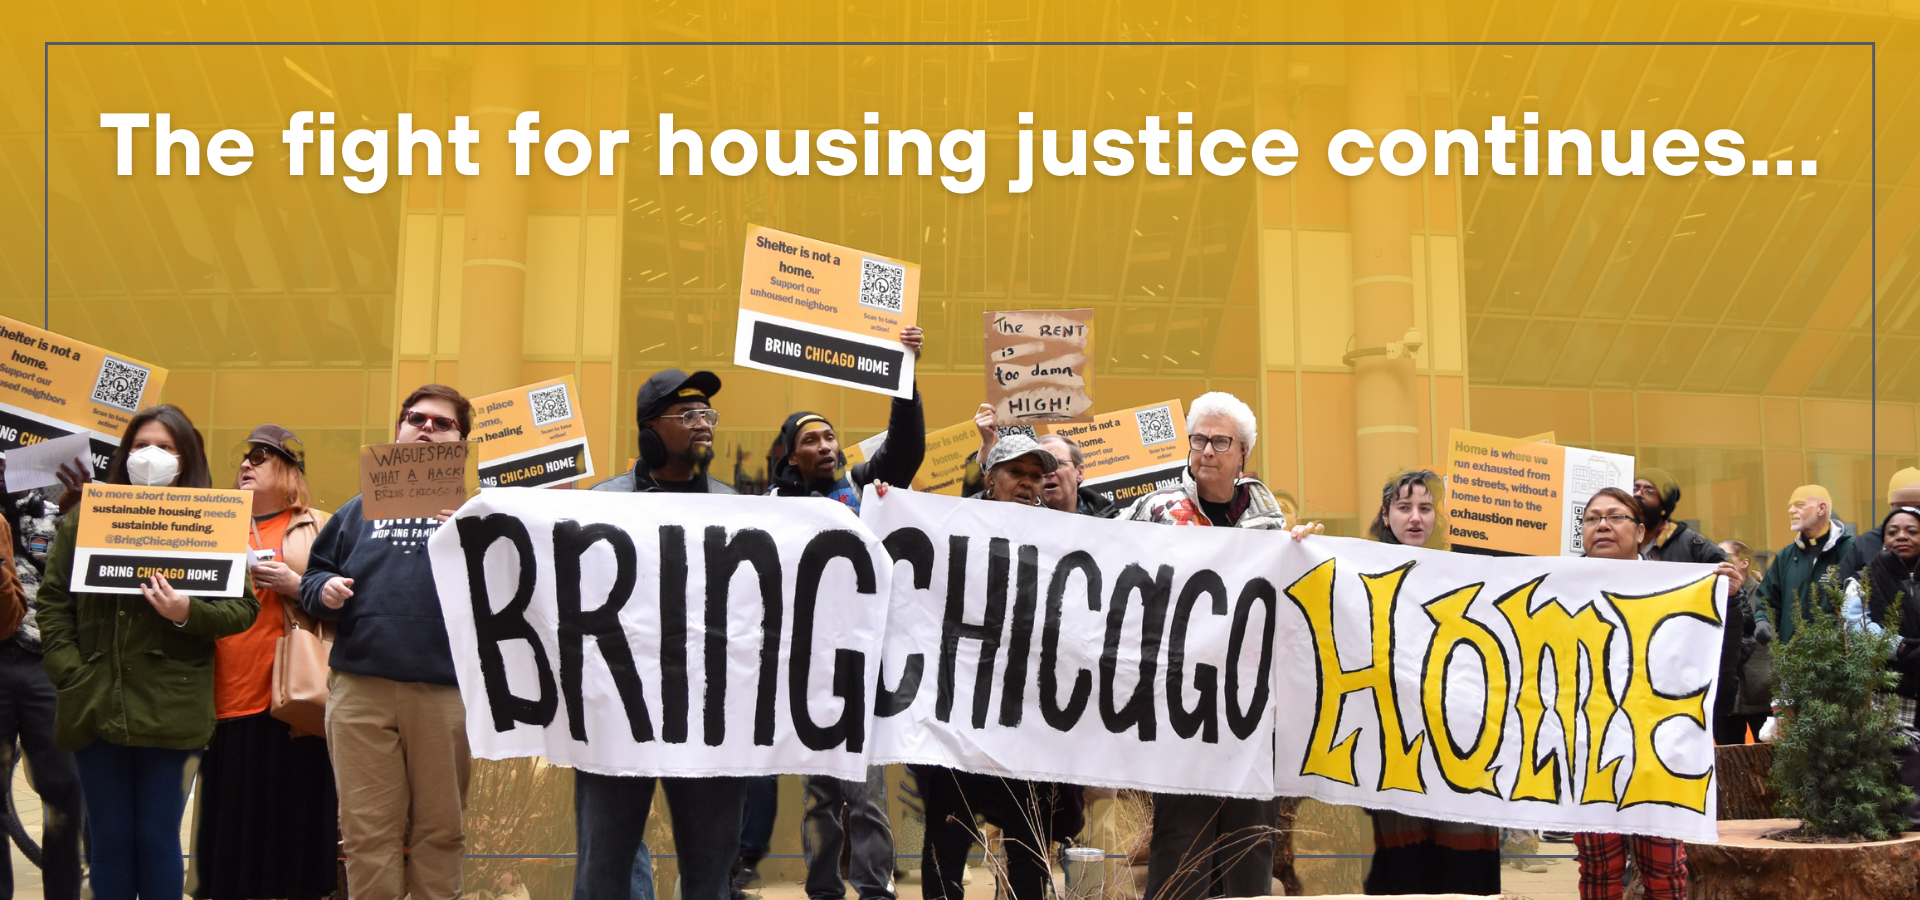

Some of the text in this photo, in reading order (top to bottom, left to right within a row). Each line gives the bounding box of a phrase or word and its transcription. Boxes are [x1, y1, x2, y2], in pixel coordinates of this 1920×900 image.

[756, 236, 840, 266] Shelter is not a
[779, 261, 814, 279] home.
[770, 276, 821, 296] Support our
[750, 288, 838, 314] unhoused neighbors
[864, 312, 877, 321] Scan
[885, 317, 898, 326] take
[994, 316, 1084, 338] The RENT
[870, 324, 890, 333] action!
[0, 325, 81, 362] helter is not a
[1002, 348, 1014, 357] is
[11, 350, 48, 370] home.
[765, 337, 890, 376] BRING CHICAGO HOME
[0, 363, 52, 386] Support our
[994, 363, 1073, 386] too damn
[22, 386, 66, 405] neighbors
[92, 408, 108, 417] Scan
[486, 400, 514, 414] place
[1008, 396, 1070, 414] HIGH!
[484, 425, 523, 441] healing
[1056, 425, 1088, 437] Shelter
[1089, 422, 1098, 431] is
[1099, 420, 1114, 430] not
[942, 436, 952, 446] is
[952, 430, 968, 443] not
[1078, 436, 1105, 448] home.
[932, 452, 962, 466] home.
[1098, 455, 1130, 466] neighbors
[1455, 441, 1548, 464] Home is where we
[369, 468, 464, 484] WHAT A HACK!
[500, 464, 544, 484] CHICAGO
[546, 456, 575, 473] HOME
[931, 465, 959, 478] Support
[1454, 460, 1550, 481] run exhausted from
[375, 489, 404, 502] BRING
[409, 487, 450, 498] CHICAGO
[1116, 482, 1154, 500] CHICAGO
[1453, 474, 1557, 498] the streets, without a
[88, 488, 244, 506] No more short term solutions,
[1452, 490, 1542, 512] home to run to the
[92, 505, 236, 518] sustainable housing needs
[1450, 508, 1548, 530] exhaustion never
[112, 520, 214, 534] sustainble funding.
[1450, 525, 1488, 540] leaves.
[105, 534, 218, 548] @BringChicagoHome
[99, 565, 134, 578] BRING
[187, 569, 218, 581] HOME
